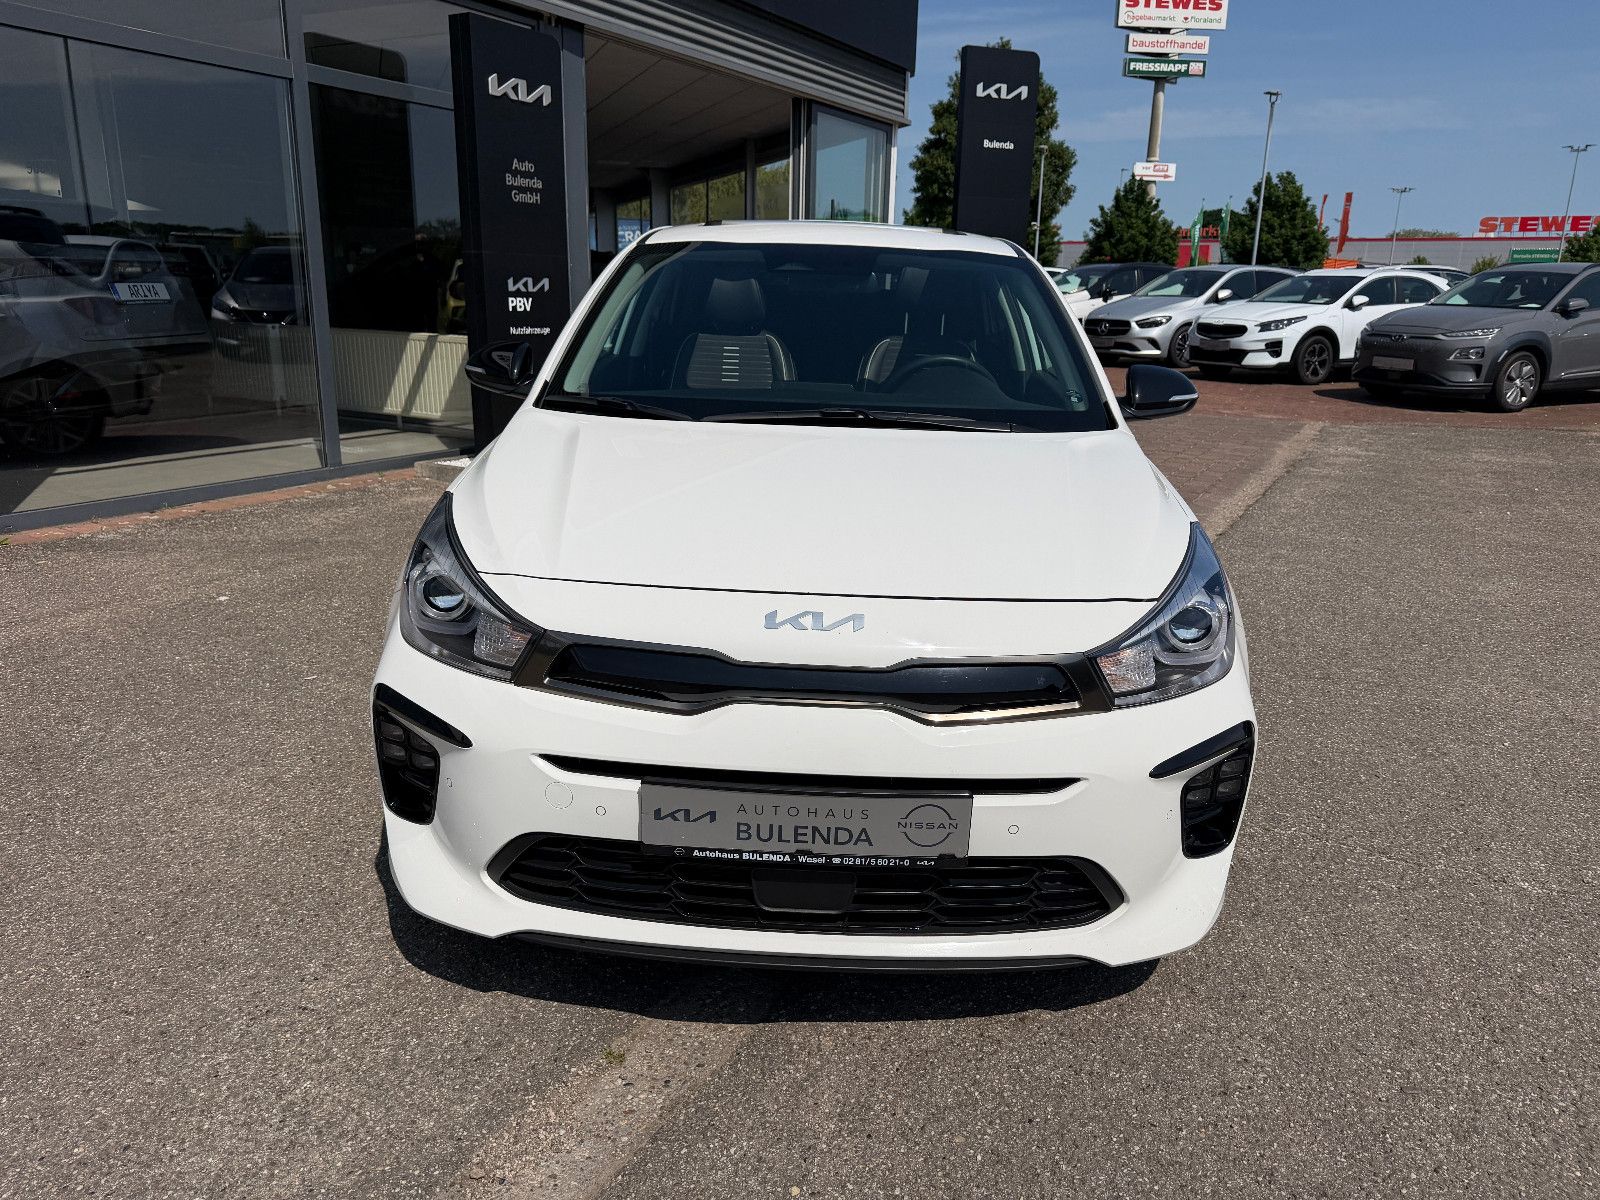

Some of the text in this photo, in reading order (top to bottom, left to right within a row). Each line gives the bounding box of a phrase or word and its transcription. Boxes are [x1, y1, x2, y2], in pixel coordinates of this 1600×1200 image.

[1125, 0, 1224, 11] STEWES
[1126, 13, 1176, 23] hagebaumarkt
[1190, 15, 1222, 24] floraland
[1131, 38, 1206, 50] baustoffhandel
[1129, 61, 1188, 73] FRESSNAPF
[488, 72, 552, 107] KIA
[976, 81, 1029, 101] KIA
[983, 139, 1014, 150] Bulenda
[511, 158, 535, 173] Auto
[505, 173, 543, 189] Bulenda
[511, 190, 541, 204] GmbH
[1478, 215, 1600, 233] STEWE
[126, 284, 161, 299] ARIYA
[507, 276, 550, 293] KIA
[508, 297, 533, 312] PBV
[509, 326, 551, 336] Nutzfahrzeuge
[763, 609, 865, 633] KIA
[653, 807, 717, 824] KIA
[736, 803, 870, 820] AUTOHAUS
[897, 821, 959, 831] NISSAN
[736, 821, 874, 847] BULENDA
[692, 849, 740, 860] Autohaus
[742, 852, 791, 863] BULENDA
[798, 855, 826, 864] Wesel
